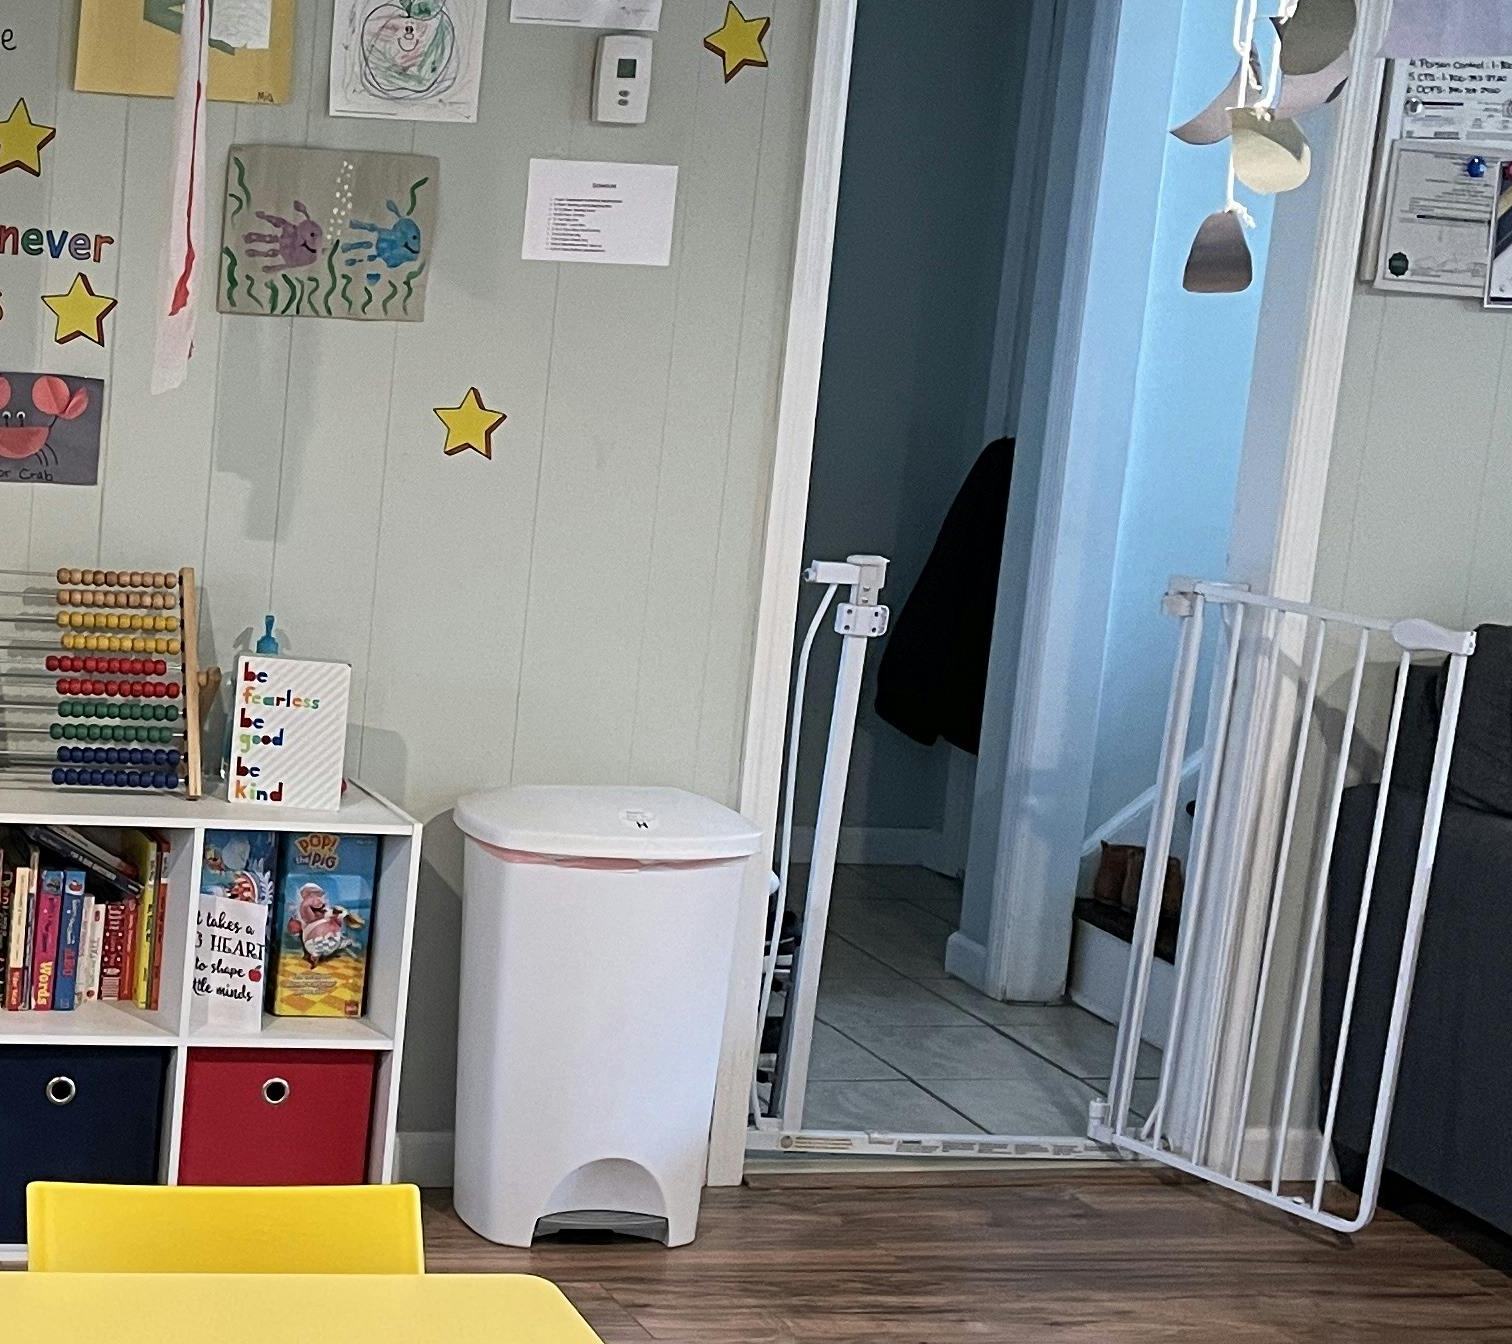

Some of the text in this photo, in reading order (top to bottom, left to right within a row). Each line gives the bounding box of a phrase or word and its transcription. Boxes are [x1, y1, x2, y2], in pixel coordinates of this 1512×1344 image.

[19, 468, 53, 481] Crab
[244, 662, 268, 683] be
[243, 687, 320, 709] fearless
[240, 708, 264, 729] be
[240, 728, 284, 753] good
[236, 757, 260, 777] be
[235, 780, 283, 801] kind
[298, 835, 338, 853] POP!
[311, 852, 336, 869] PIG
[207, 912, 255, 935] takes a
[211, 934, 265, 960] HEART
[195, 956, 245, 978] to shape
[38, 961, 53, 1005] Words
[216, 984, 252, 1001] minds
